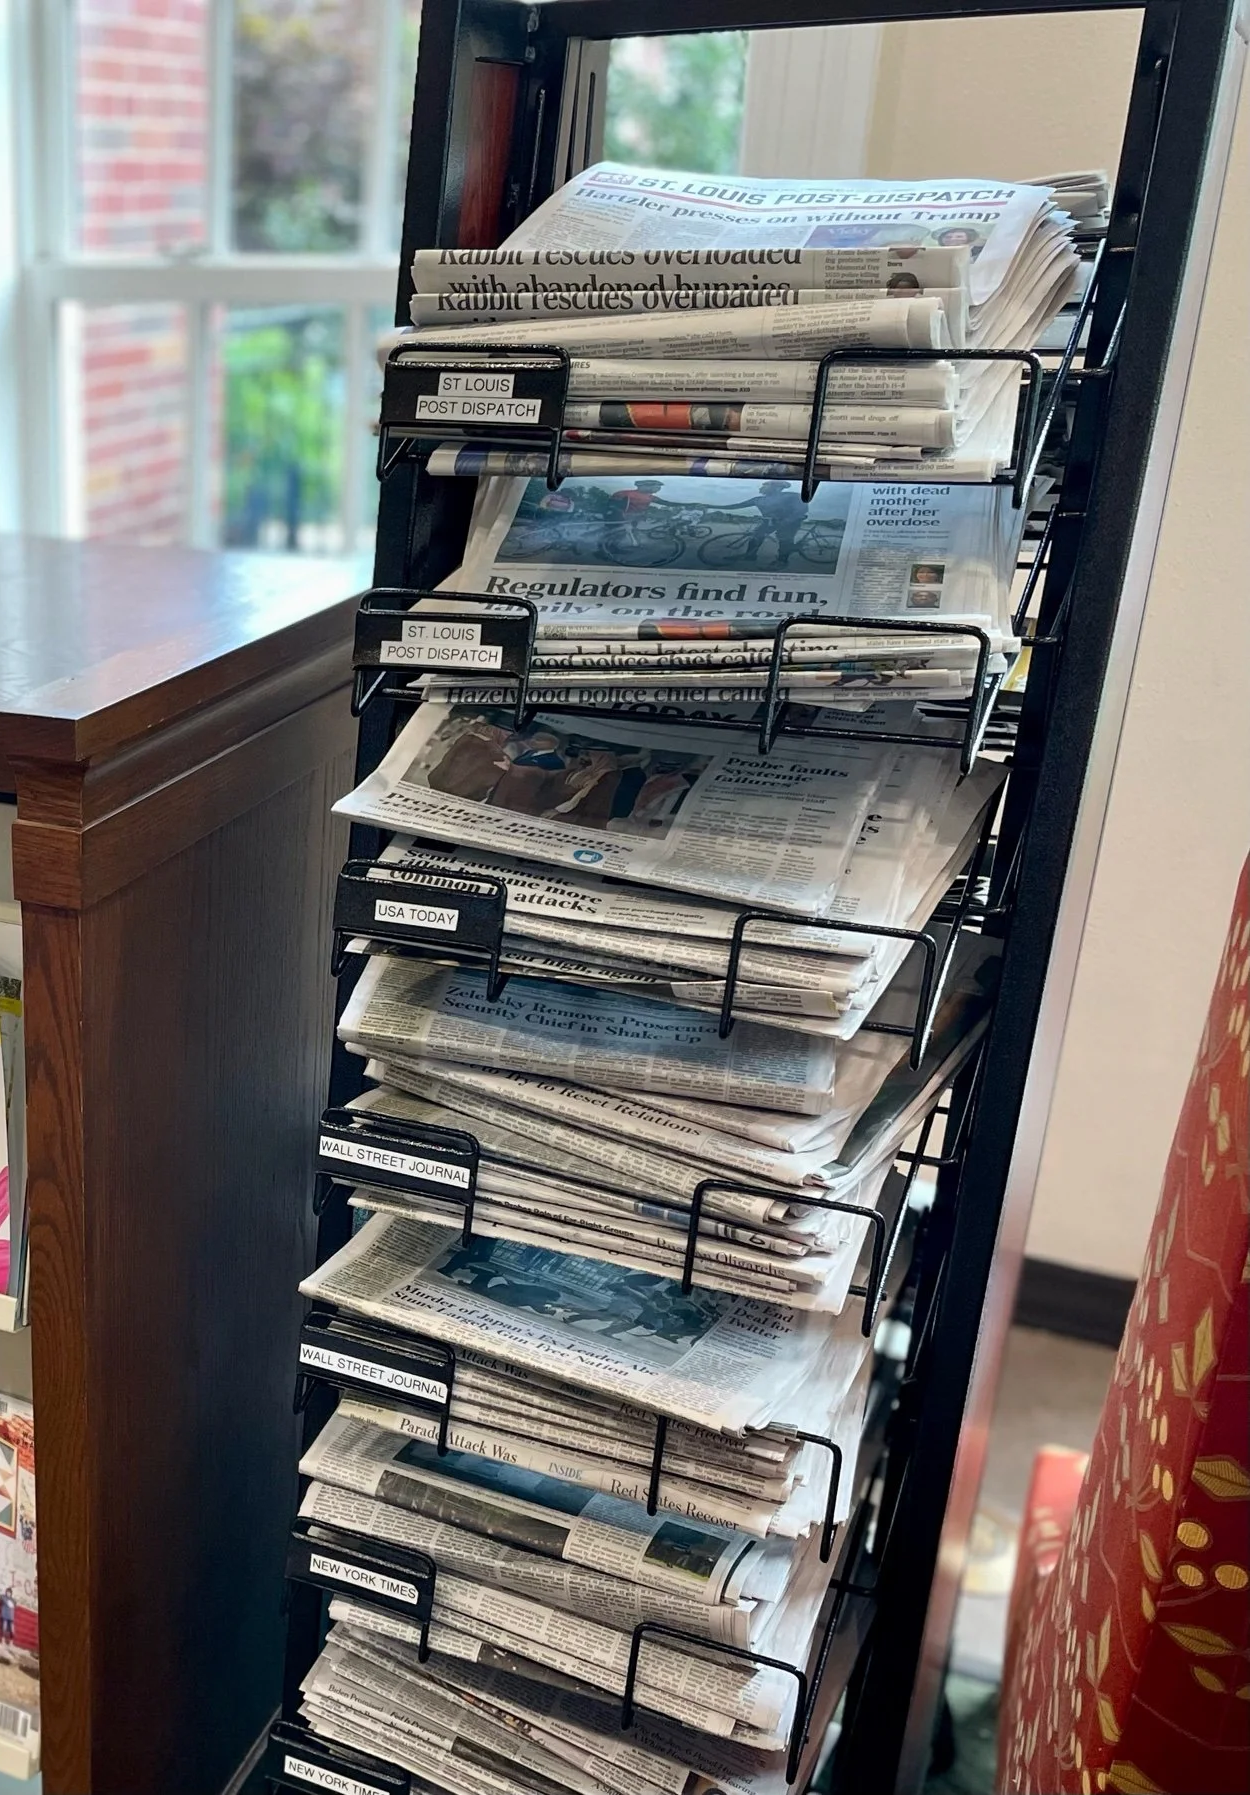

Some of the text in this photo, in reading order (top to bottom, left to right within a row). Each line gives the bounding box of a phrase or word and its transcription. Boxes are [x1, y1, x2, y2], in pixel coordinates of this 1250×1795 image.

[637, 176, 1016, 205] ST. LOUIS POST-DISPATCH
[673, 207, 761, 226] presses
[766, 214, 799, 224] on
[806, 209, 903, 223] without
[909, 209, 1001, 224] Trump
[437, 249, 802, 266] Rabbit rescues overloaded
[449, 274, 791, 293] with abandoned bunnies
[437, 289, 799, 311] Rabbit rescues overloaded
[443, 378, 510, 392] ST LOUIS
[419, 401, 536, 417] POST DISPATCH
[870, 497, 930, 505] mother
[873, 487, 950, 495] with dead
[866, 518, 940, 526] overdose
[868, 508, 940, 516] after her
[484, 575, 828, 606] Regulators find fun,
[408, 626, 475, 641] ST. LOUIS
[387, 646, 498, 663] POST DISPATCH
[726, 757, 849, 778] Probe faults
[403, 849, 574, 887] Semi-automatic
[513, 890, 598, 915] attacks
[546, 887, 603, 905] more
[378, 905, 455, 925] USA TODAY
[441, 997, 520, 1021] Security
[524, 1011, 575, 1033] Chief
[580, 1020, 598, 1033] in
[321, 1140, 468, 1183] WALL STREET JOURNAL
[401, 1284, 456, 1310] Murder
[460, 1306, 477, 1320] of
[478, 1313, 533, 1341] Japan's
[630, 1363, 659, 1378] Abe
[728, 1316, 781, 1340] Twitter
[733, 1307, 793, 1334] Deal for
[391, 1290, 630, 1377] Stuns Largely Gun-Free Nation
[301, 1348, 445, 1398] WALL STREET JOURNAL
[492, 1443, 518, 1464] Was
[548, 1461, 583, 1481] INSIDE
[611, 1479, 740, 1531] Red Sates Recover
[312, 1558, 416, 1599] NEW YORK TIMES
[289, 1761, 315, 1778] NEW
[318, 1770, 349, 1792] YORK
